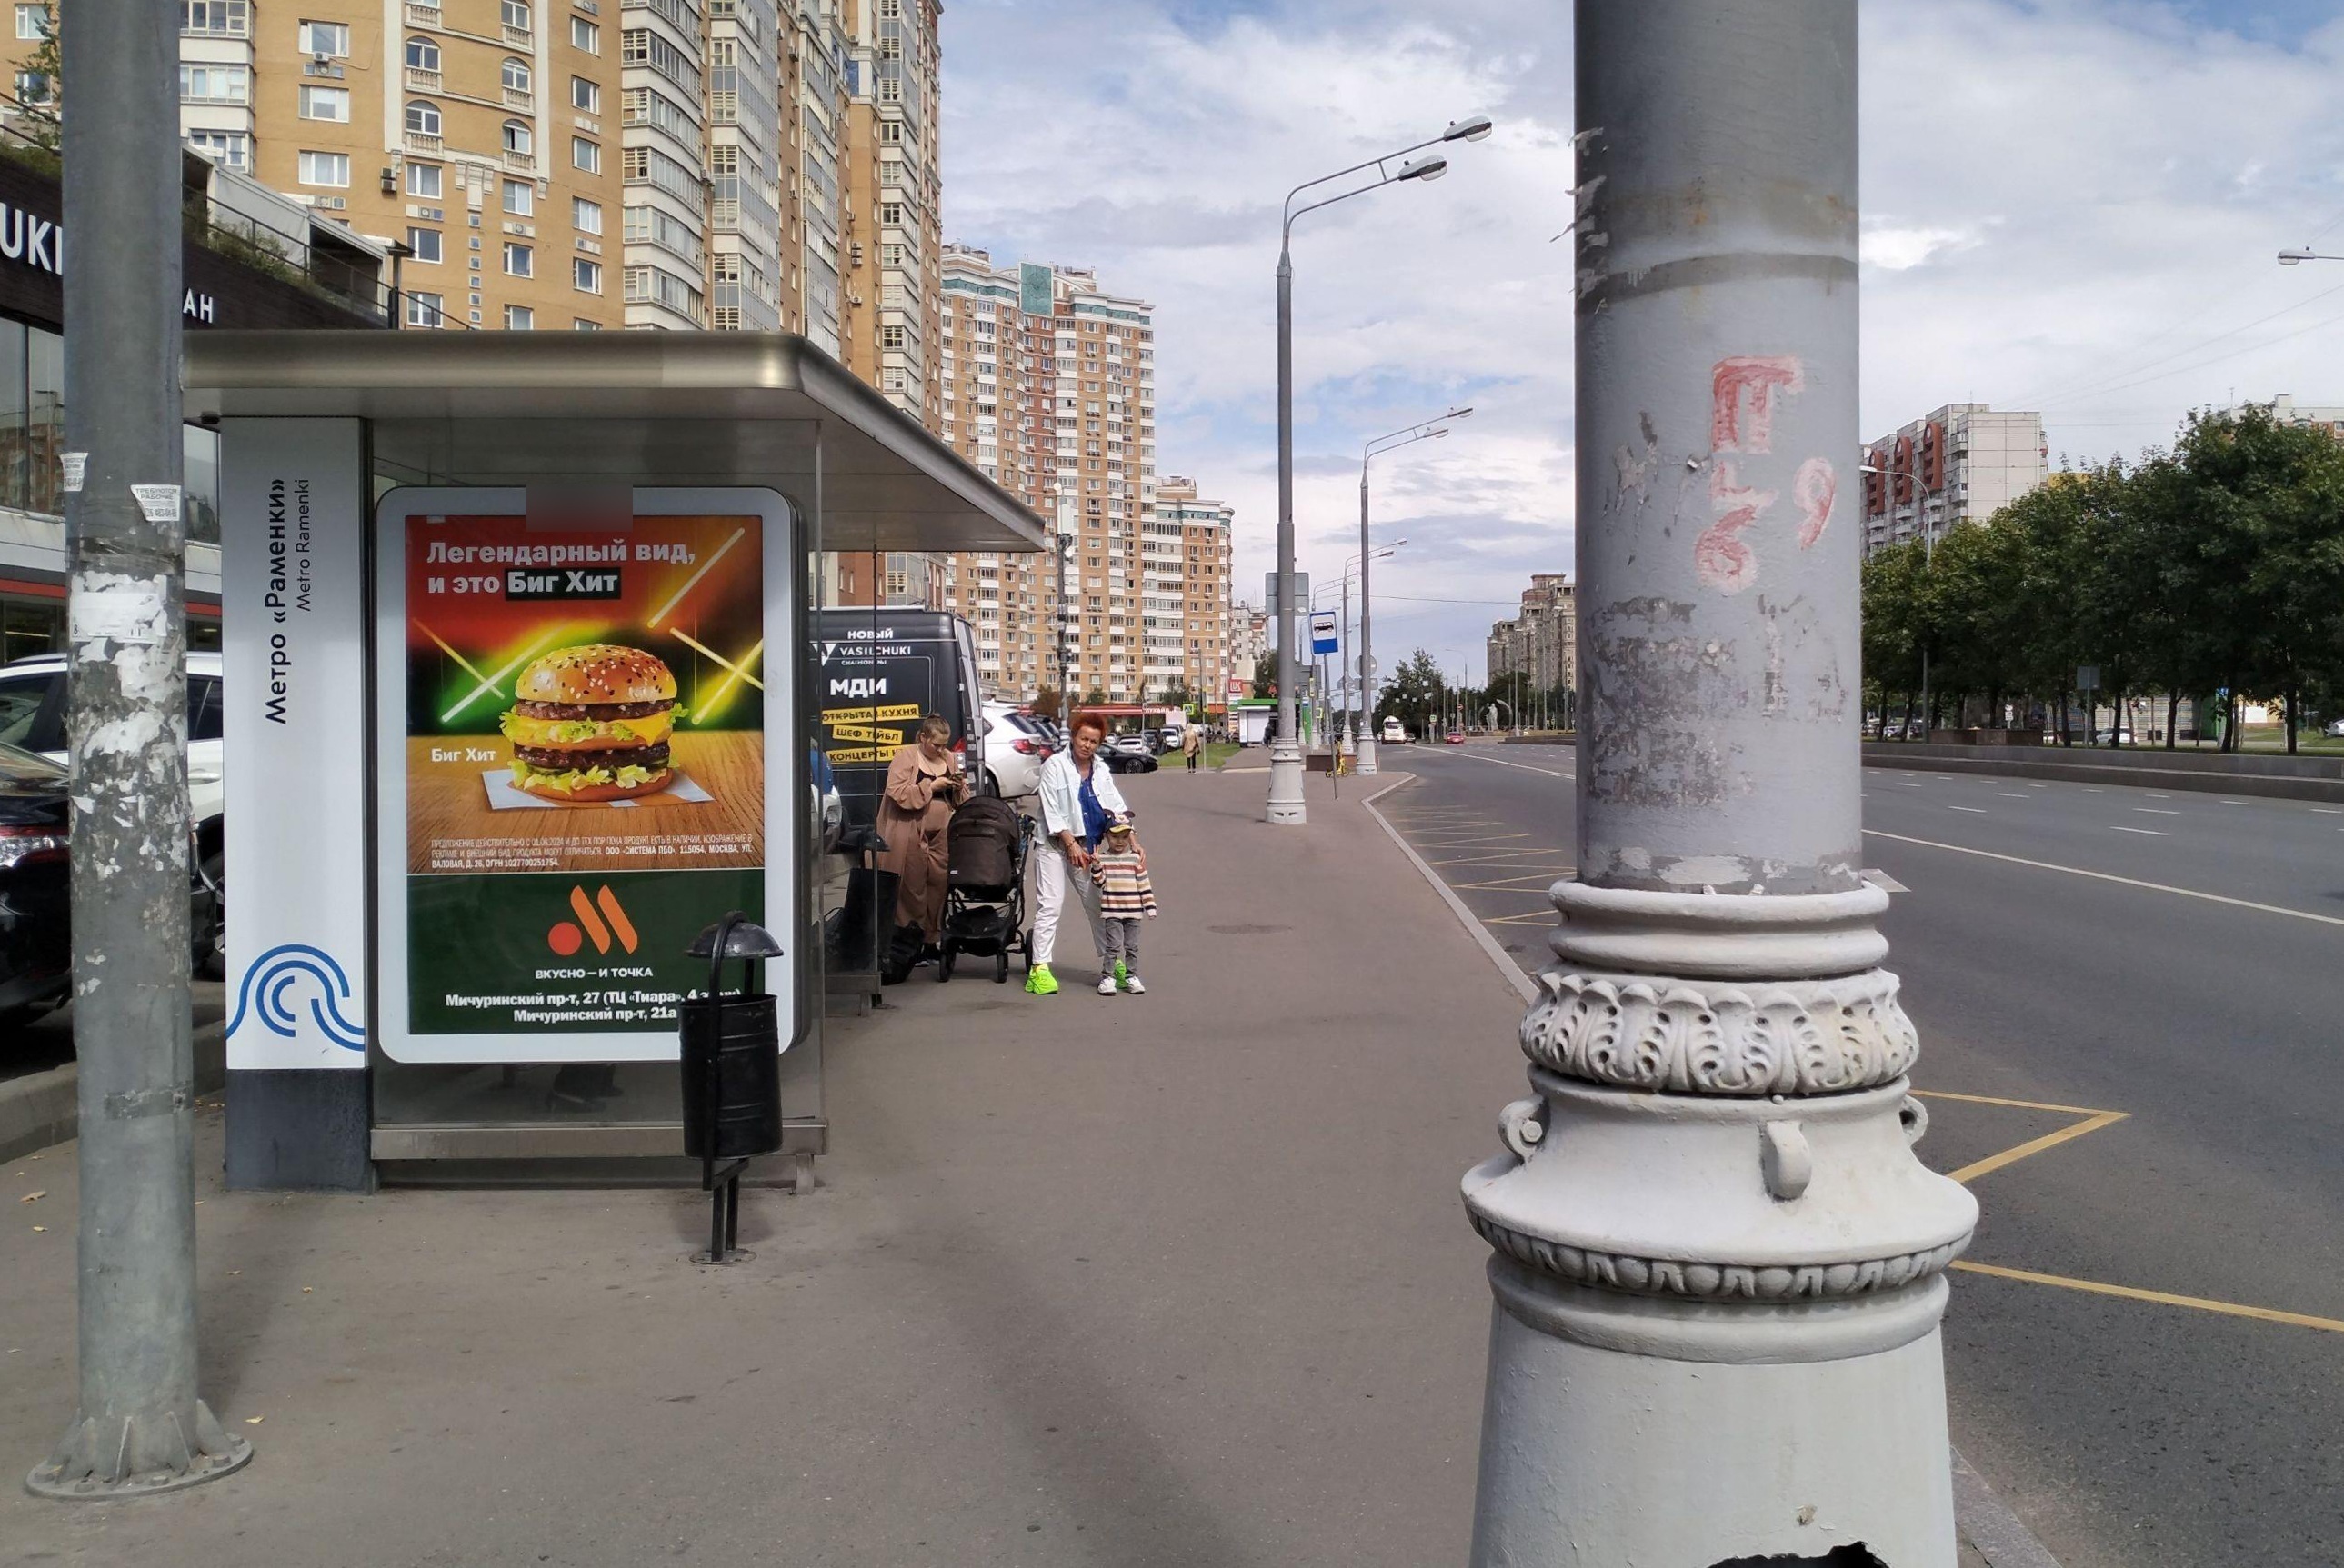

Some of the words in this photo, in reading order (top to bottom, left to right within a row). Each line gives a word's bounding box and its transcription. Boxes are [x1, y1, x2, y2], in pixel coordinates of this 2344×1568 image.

[183, 287, 214, 324] АН
[294, 479, 310, 553] Ramenki
[265, 479, 286, 624] «Раменки»
[426, 538, 627, 566] Легендарный
[635, 544, 696, 565] вид,
[296, 558, 311, 612] Metro
[428, 578, 445, 594] и
[452, 576, 501, 594] это
[507, 571, 559, 593] Биг
[566, 572, 619, 593] Хит
[847, 627, 894, 640] НОВЫЙ
[839, 645, 911, 656] VASILCHUKI
[265, 633, 291, 724] Метро
[830, 678, 887, 699] МДИ
[881, 707, 917, 717] КУХНЯ
[866, 730, 899, 741] ТЙБЛ
[431, 748, 462, 763] Биг
[466, 747, 496, 762] Хит
[605, 846, 620, 854] ООО
[431, 859, 465, 869] ВАЛОВАЯ,
[486, 859, 503, 867] ОГРН
[535, 968, 586, 979] ВКУСНО
[598, 968, 607, 978] И
[611, 967, 654, 977] ТОЧКА
[445, 992, 545, 1009] Мичуринский
[547, 994, 580, 1007] пр-т,
[583, 992, 600, 1004] 27
[604, 991, 626, 1005] (ТЦ
[514, 1007, 613, 1024] Мичуринский
[616, 1009, 648, 1021] пр-т,
[650, 1007, 677, 1019] 21а
